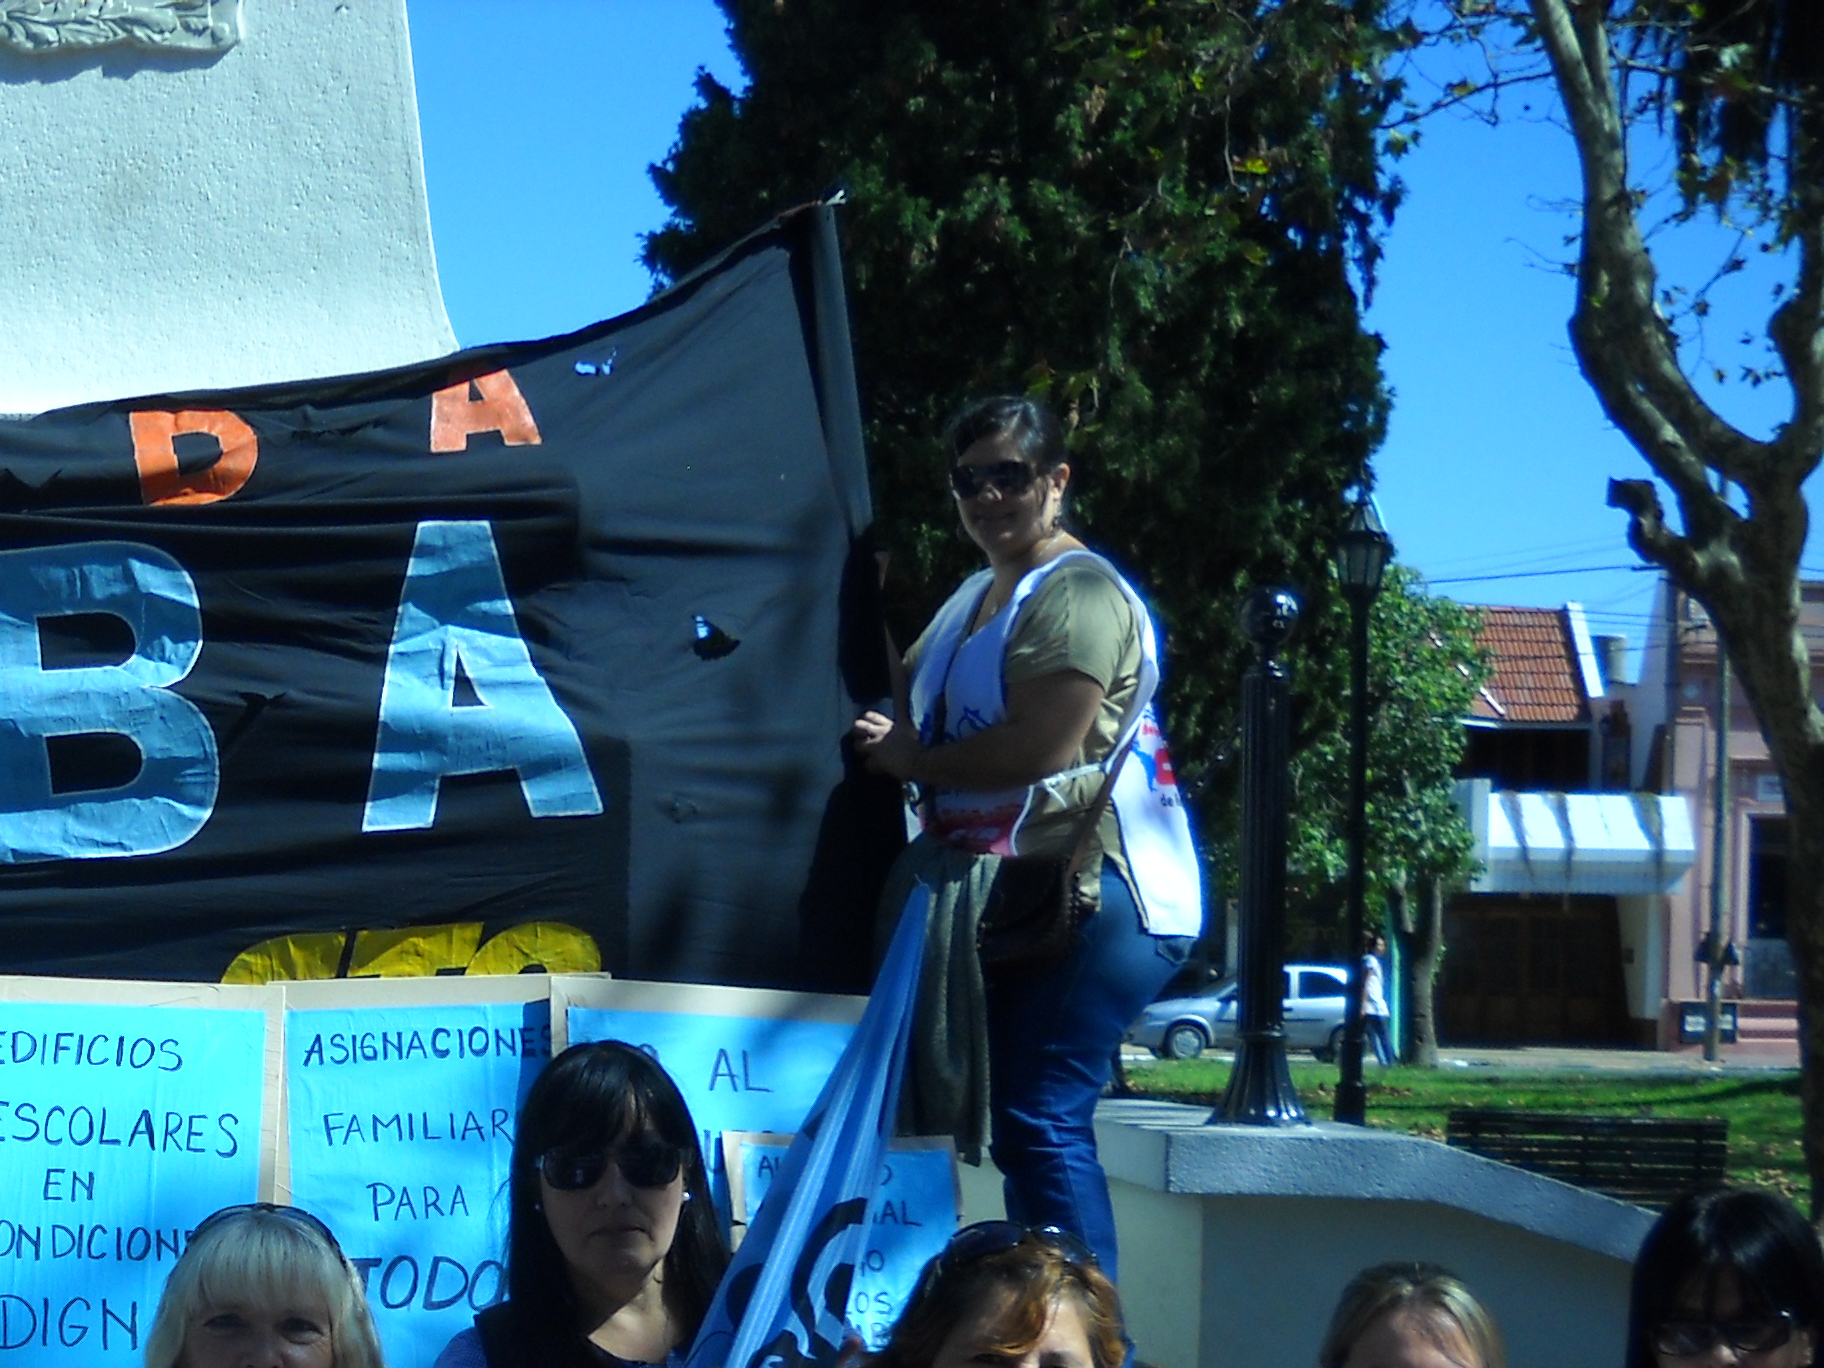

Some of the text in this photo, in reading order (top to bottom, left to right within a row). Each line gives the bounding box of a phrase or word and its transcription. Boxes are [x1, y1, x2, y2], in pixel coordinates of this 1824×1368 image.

[707, 1047, 774, 1093] AL
[322, 1107, 513, 1147] FAMILIAR
[43, 1168, 95, 1202] EN
[366, 1181, 470, 1222] PARA
[350, 1254, 505, 1313] TODO
